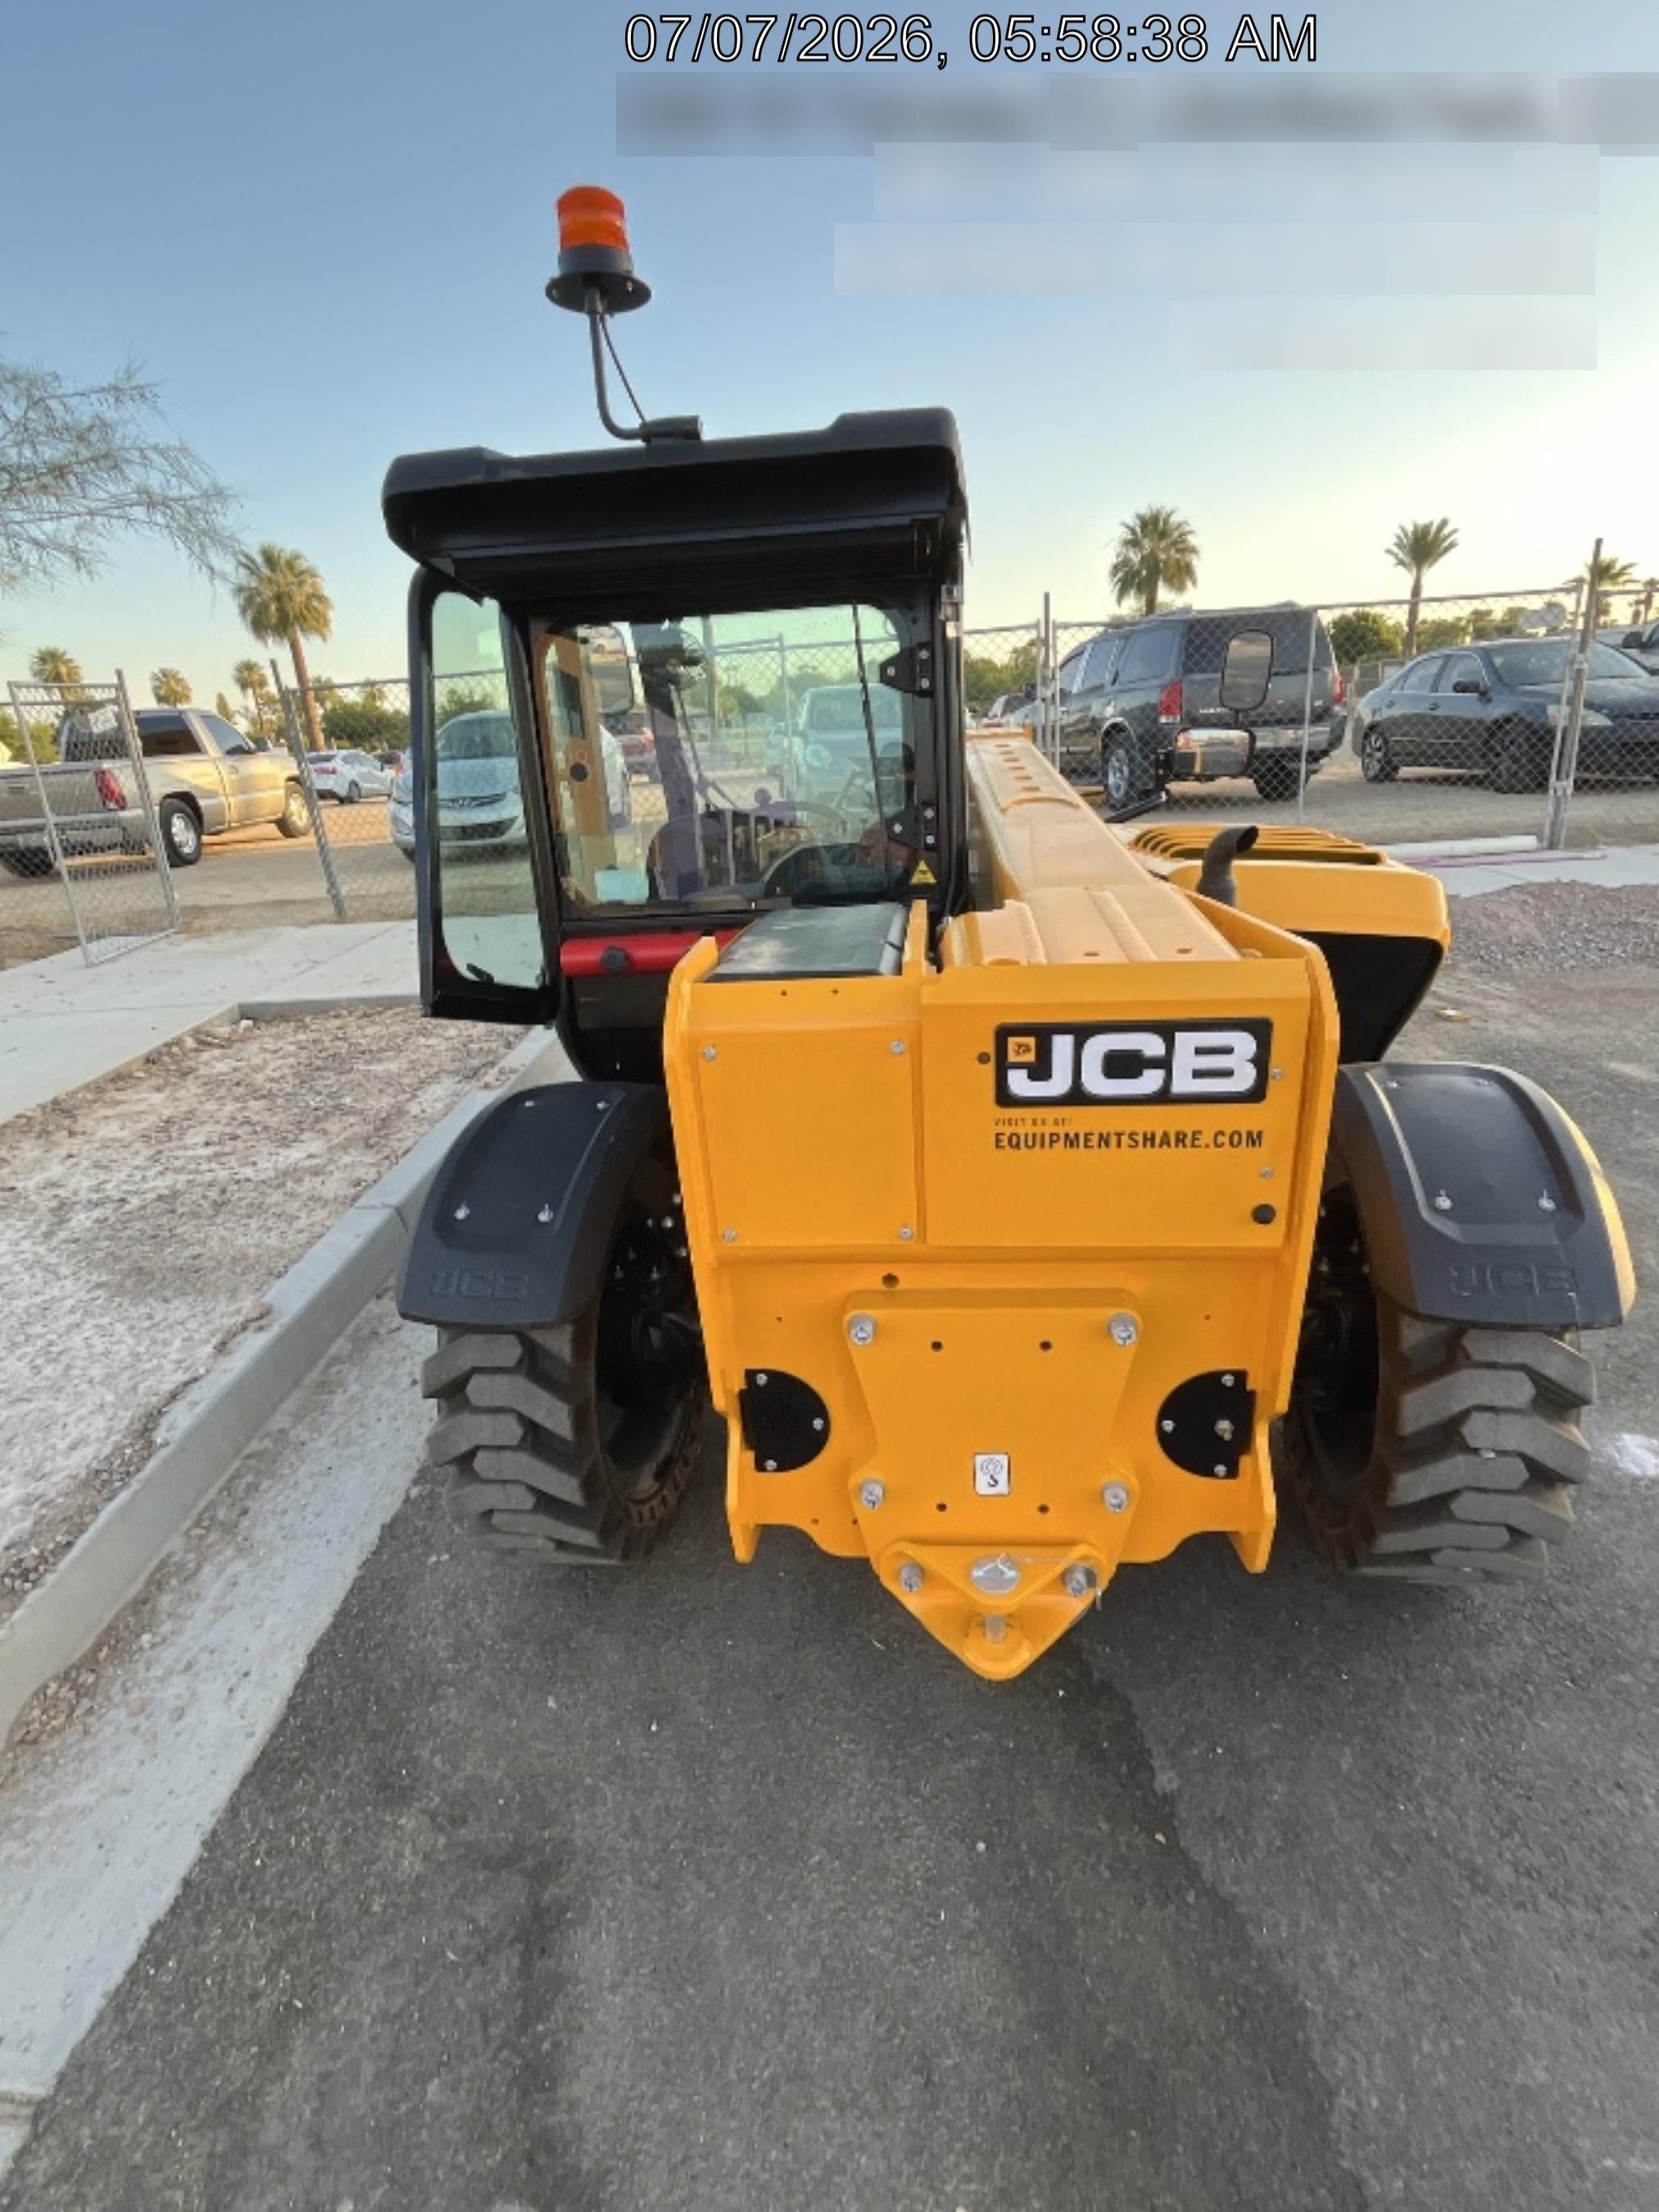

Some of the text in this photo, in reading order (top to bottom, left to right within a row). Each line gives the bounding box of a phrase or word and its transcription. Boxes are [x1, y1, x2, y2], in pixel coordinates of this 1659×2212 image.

[1007, 1031, 1258, 1098] JCB
[995, 1130, 1264, 1150] EQUIPMENTSHARE.COM
[431, 1271, 529, 1299] JCB
[1450, 1264, 1578, 1297] JCB
